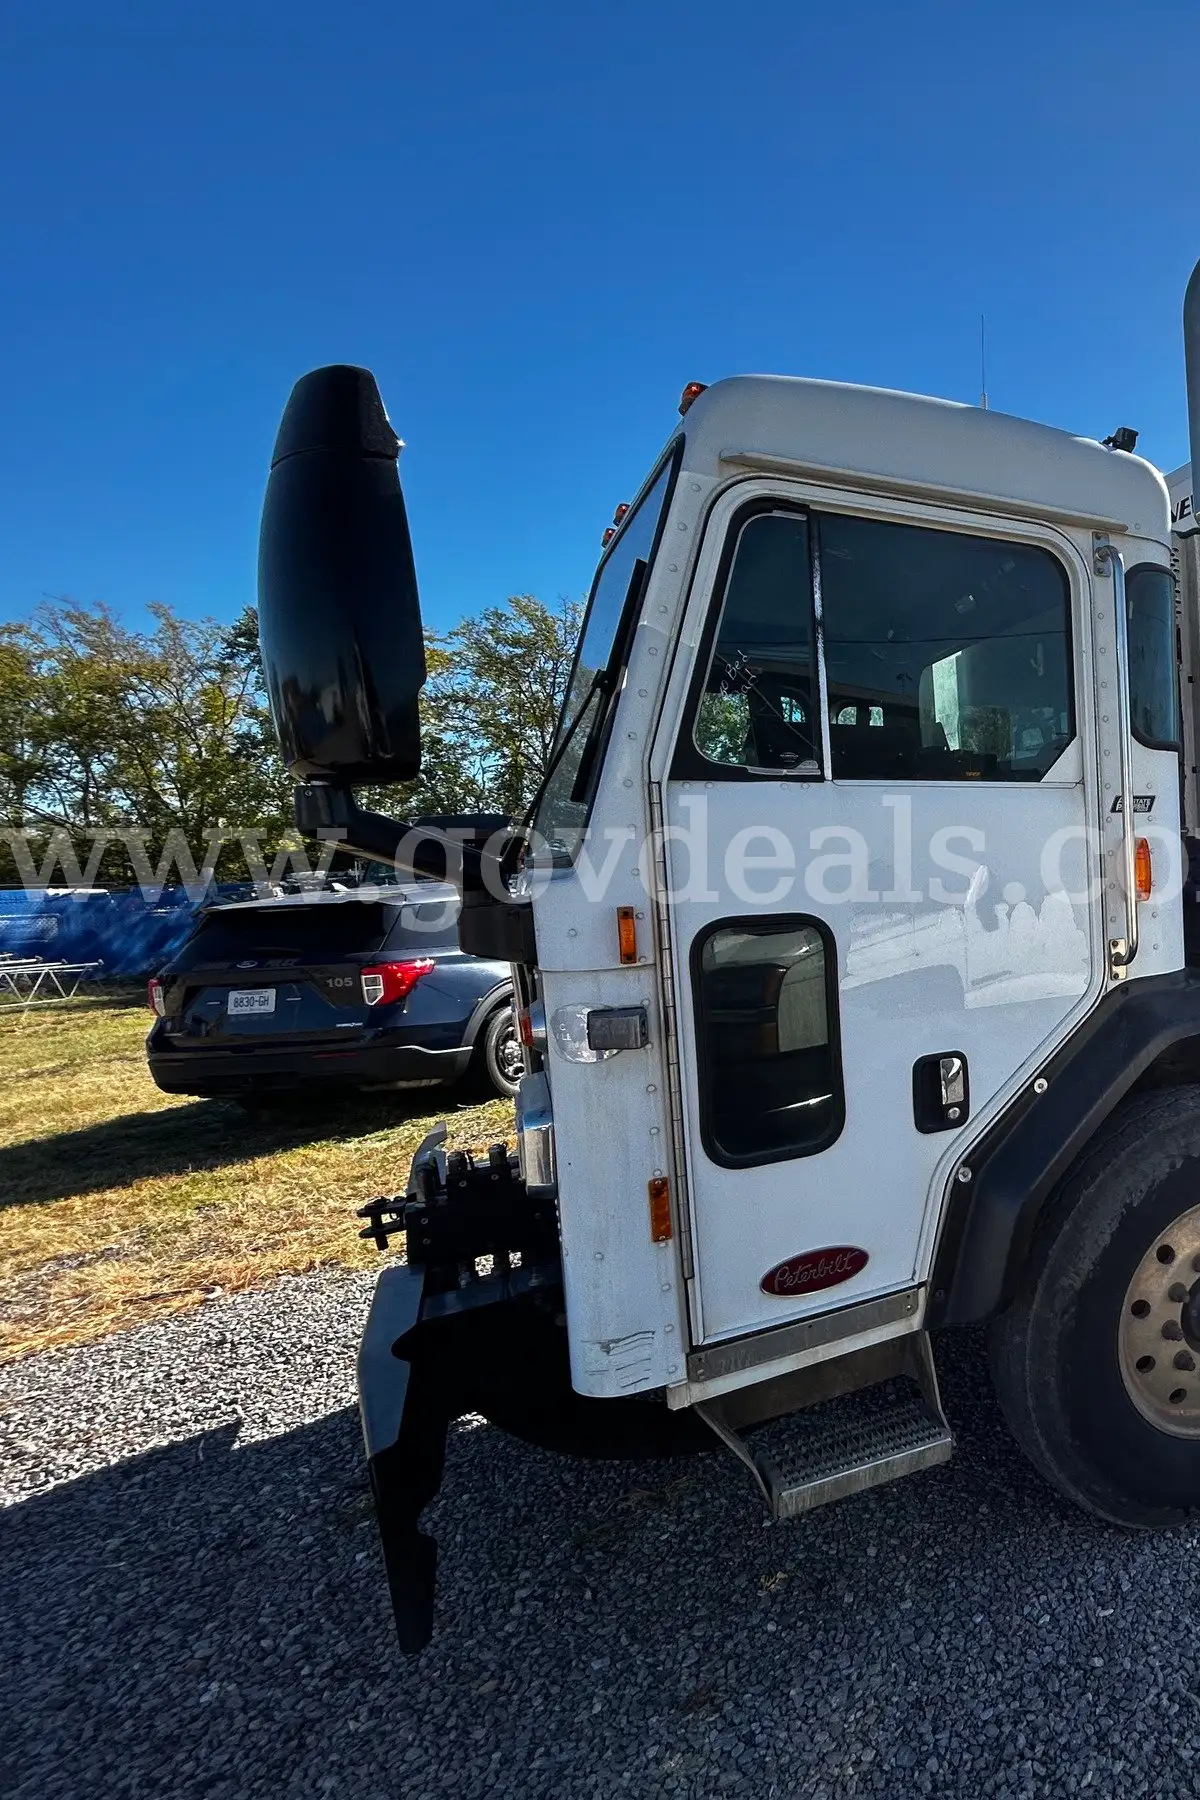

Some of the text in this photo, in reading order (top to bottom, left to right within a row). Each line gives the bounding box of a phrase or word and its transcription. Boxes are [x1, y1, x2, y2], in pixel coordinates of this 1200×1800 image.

[325, 977, 353, 988] 105
[233, 995, 270, 1008] 8830-GH
[773, 1251, 861, 1292] Peterbilt
